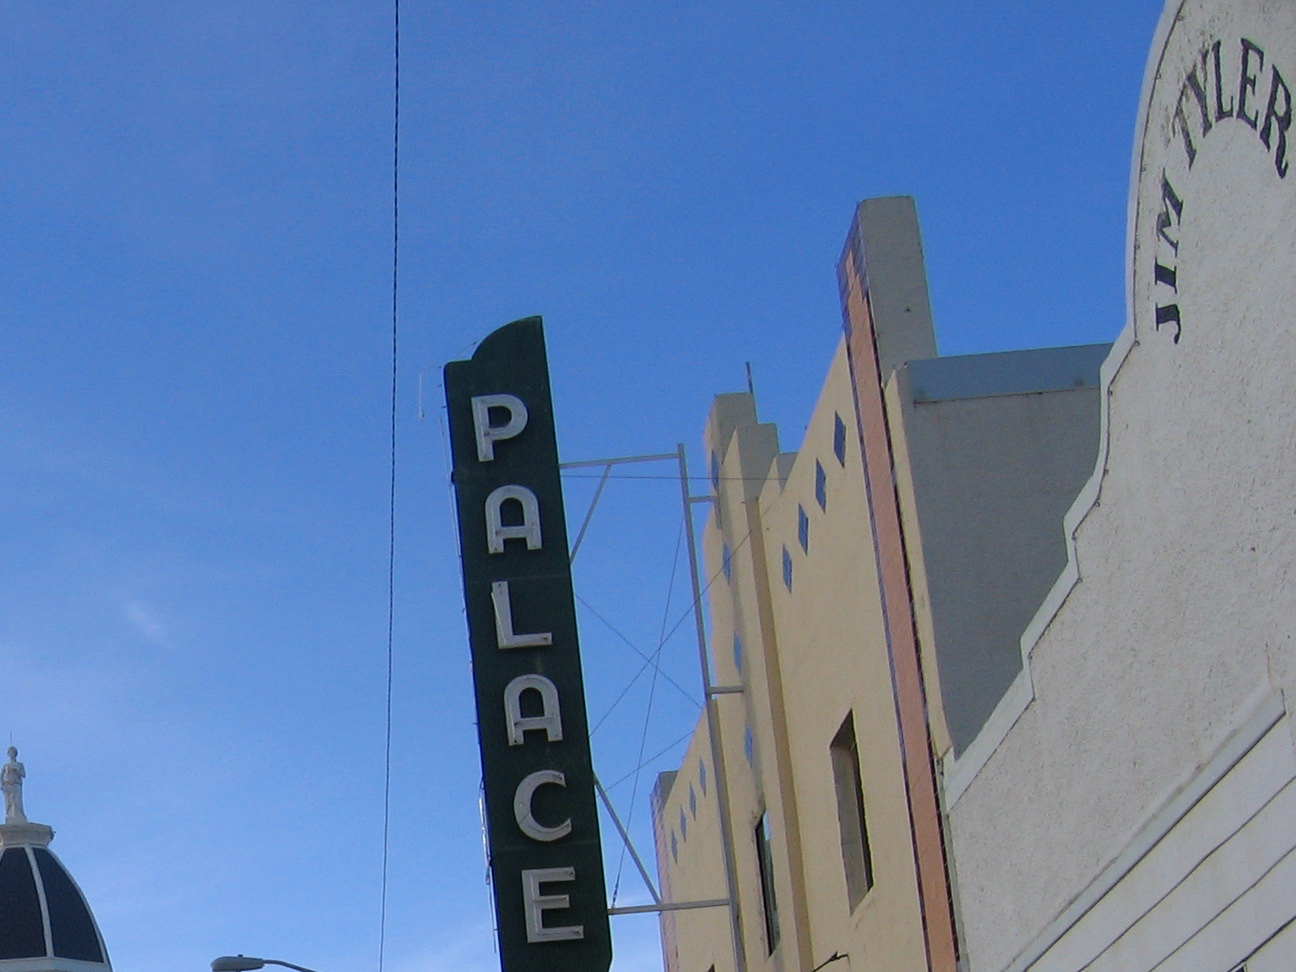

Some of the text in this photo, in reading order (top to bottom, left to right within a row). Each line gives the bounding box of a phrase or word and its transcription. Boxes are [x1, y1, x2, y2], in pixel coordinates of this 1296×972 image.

[1154, 37, 1293, 345] JIM TYLER
[470, 392, 586, 944] PALACE
